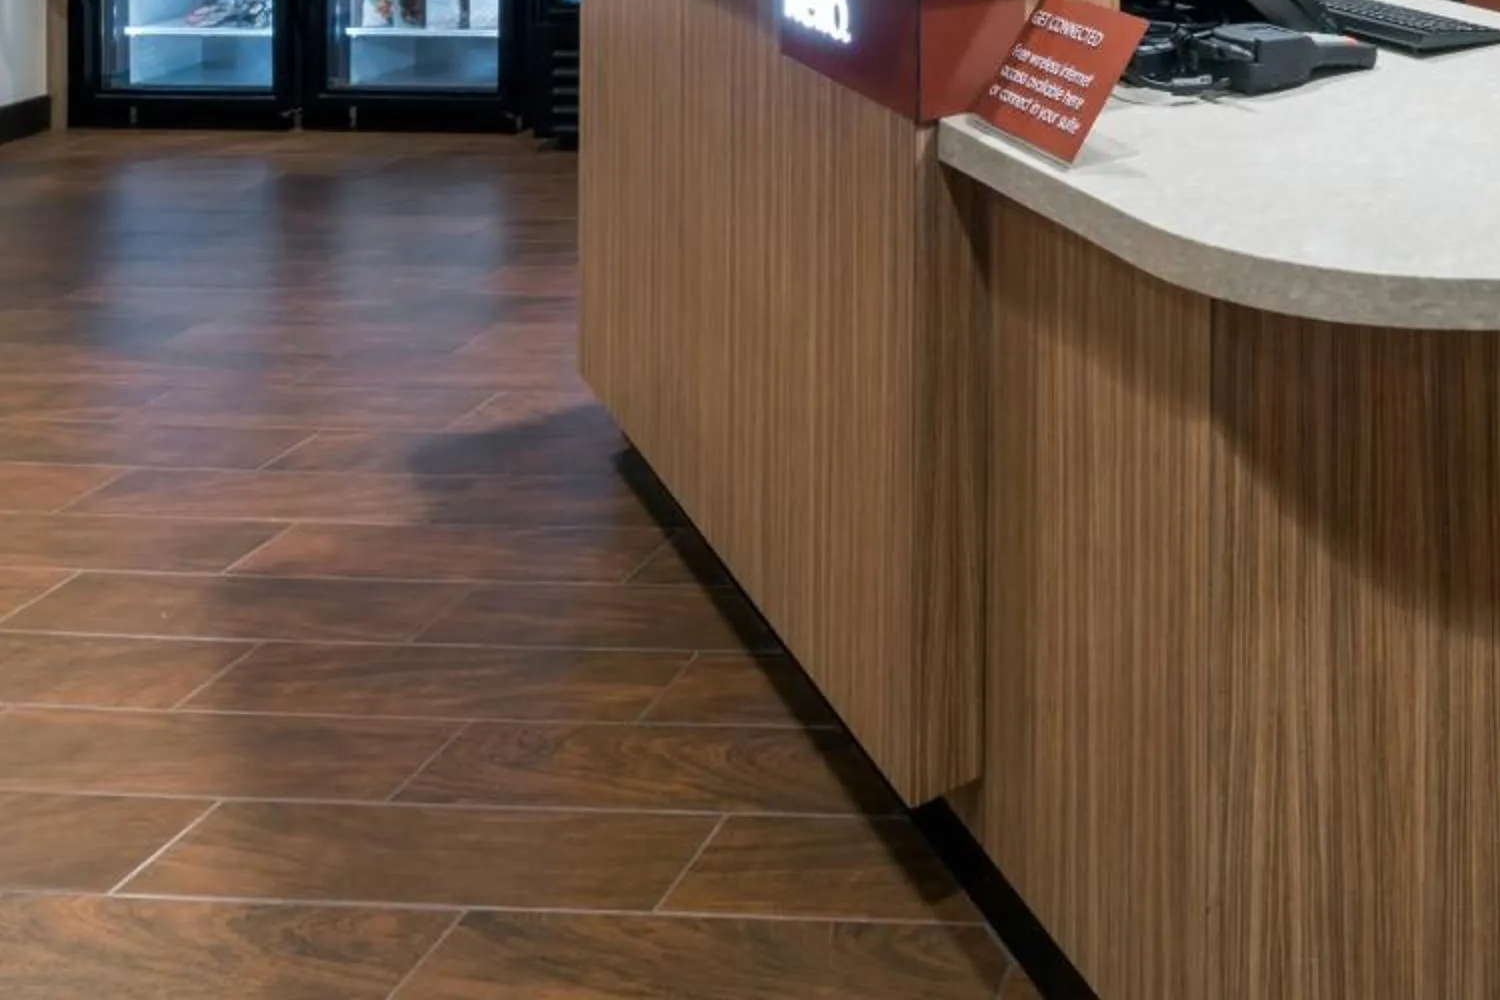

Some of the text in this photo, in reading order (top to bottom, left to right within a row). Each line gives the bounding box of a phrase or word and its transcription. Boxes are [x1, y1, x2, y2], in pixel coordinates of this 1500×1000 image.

[1031, 10, 1104, 47] GET CONNECTED
[1029, 53, 1062, 75] wireless
[988, 84, 1001, 97] or
[999, 88, 1033, 112] connect
[1001, 64, 1029, 85] access
[1026, 75, 1064, 101] available
